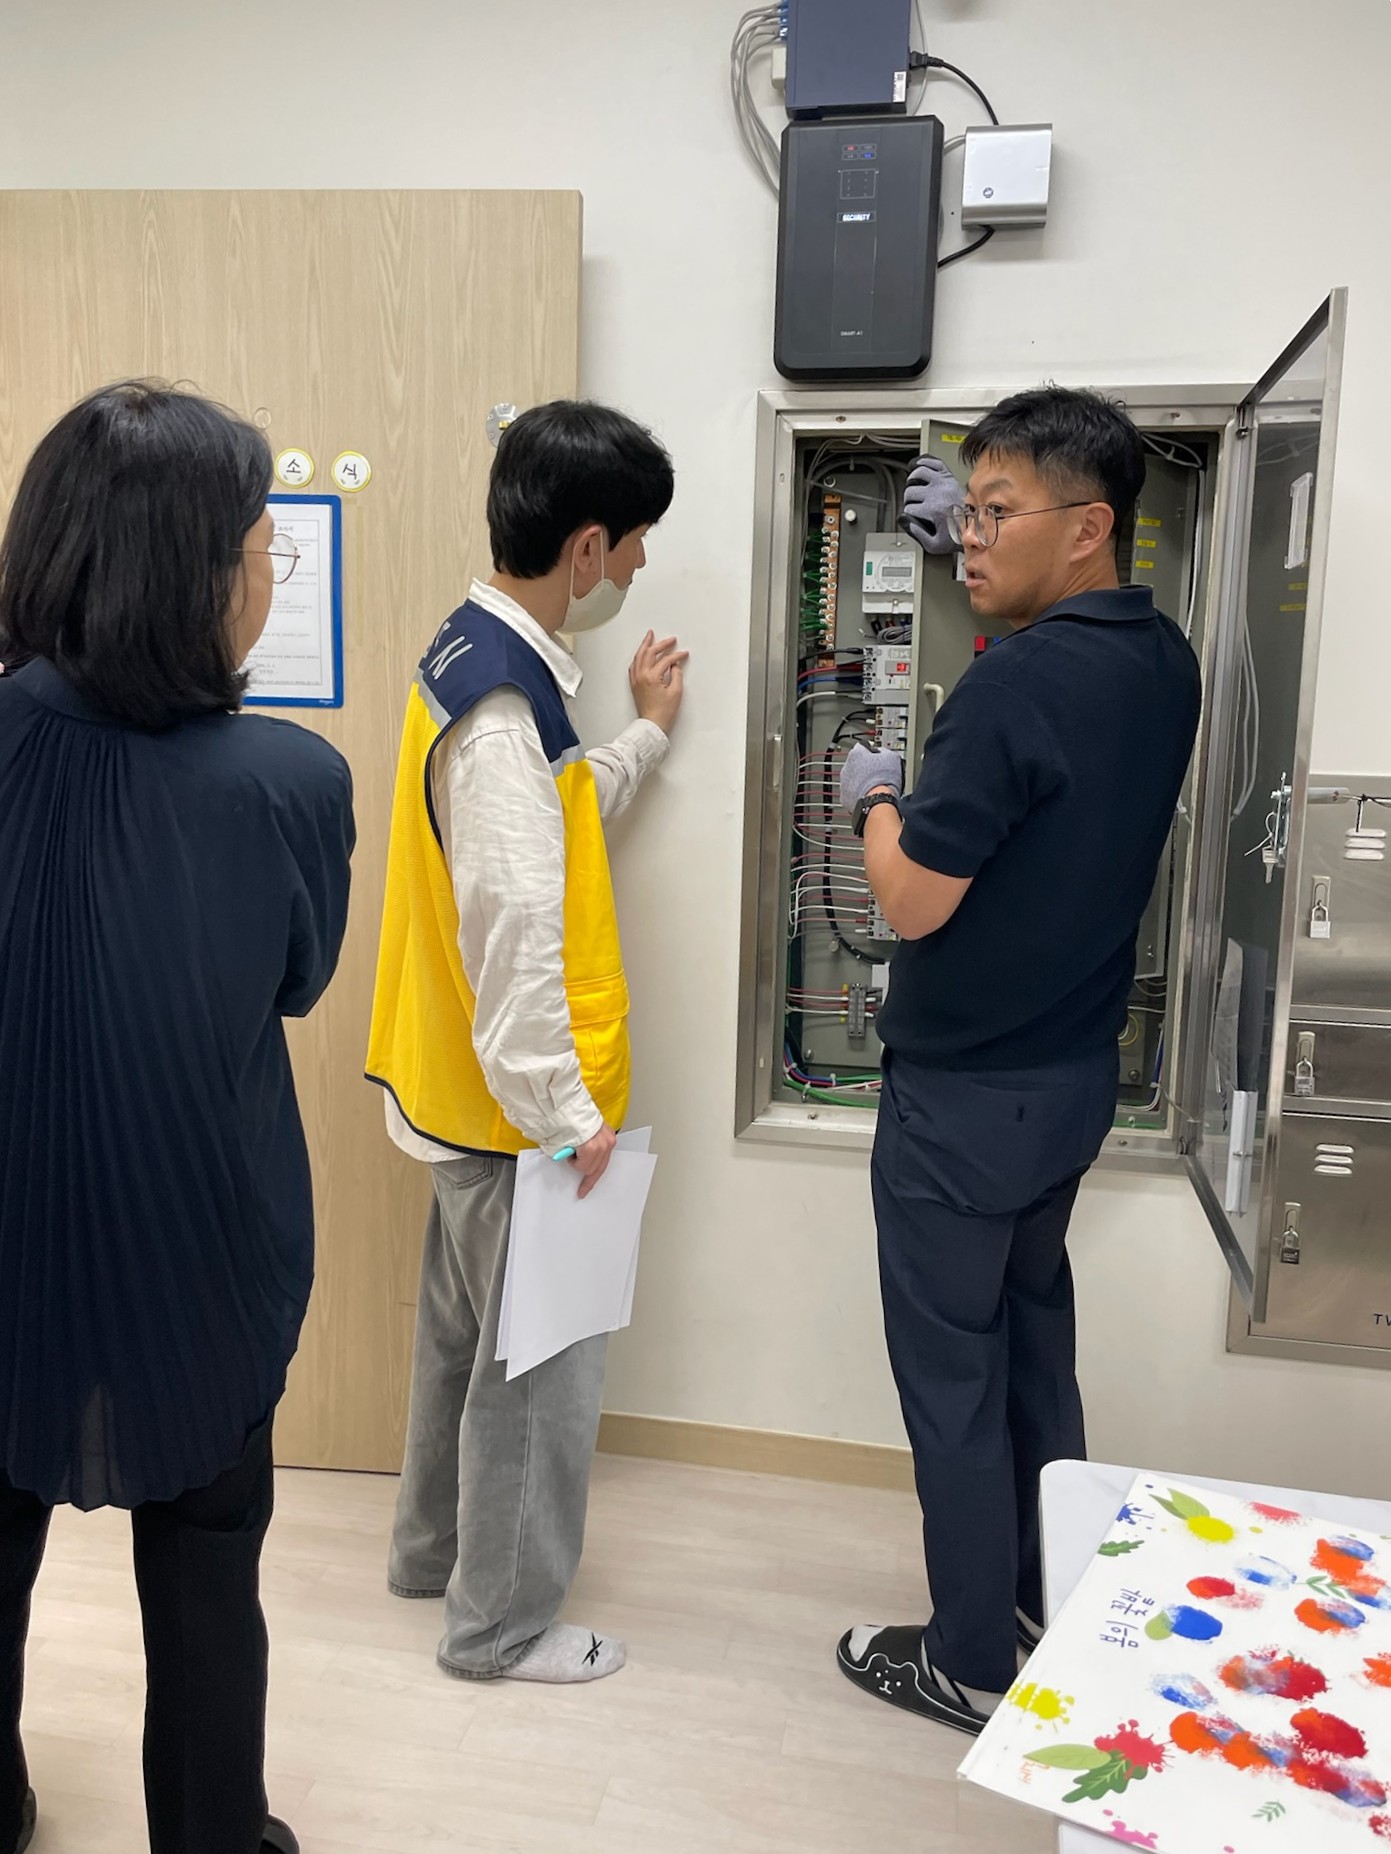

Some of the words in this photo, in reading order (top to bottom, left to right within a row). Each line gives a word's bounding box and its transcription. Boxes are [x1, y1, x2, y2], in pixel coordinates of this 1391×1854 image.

[842, 213, 870, 222] SECURITY
[286, 458, 301, 474] 소
[342, 463, 357, 480] 식
[1110, 1588, 1155, 1617] 꽃밭
[1099, 1620, 1139, 1648] 봄의
